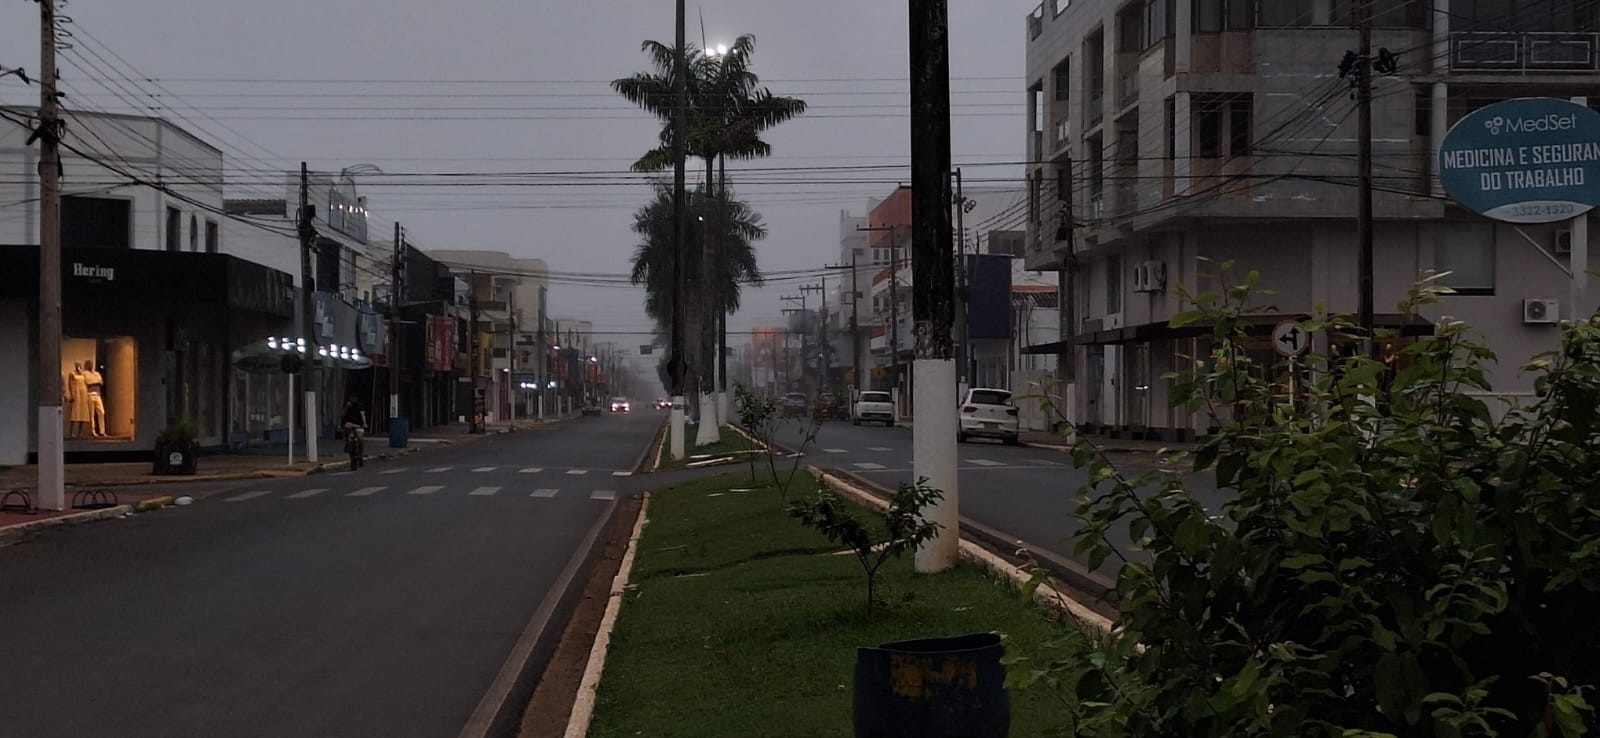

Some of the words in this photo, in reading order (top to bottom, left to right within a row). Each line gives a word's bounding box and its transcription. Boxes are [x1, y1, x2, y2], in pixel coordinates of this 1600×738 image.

[1505, 113, 1577, 133] MedSet
[1444, 148, 1515, 169] MEDICINA
[1519, 147, 1529, 165] E
[1480, 172, 1501, 191] DO
[1505, 167, 1585, 190] TRABALHO
[73, 262, 114, 281] Hering
